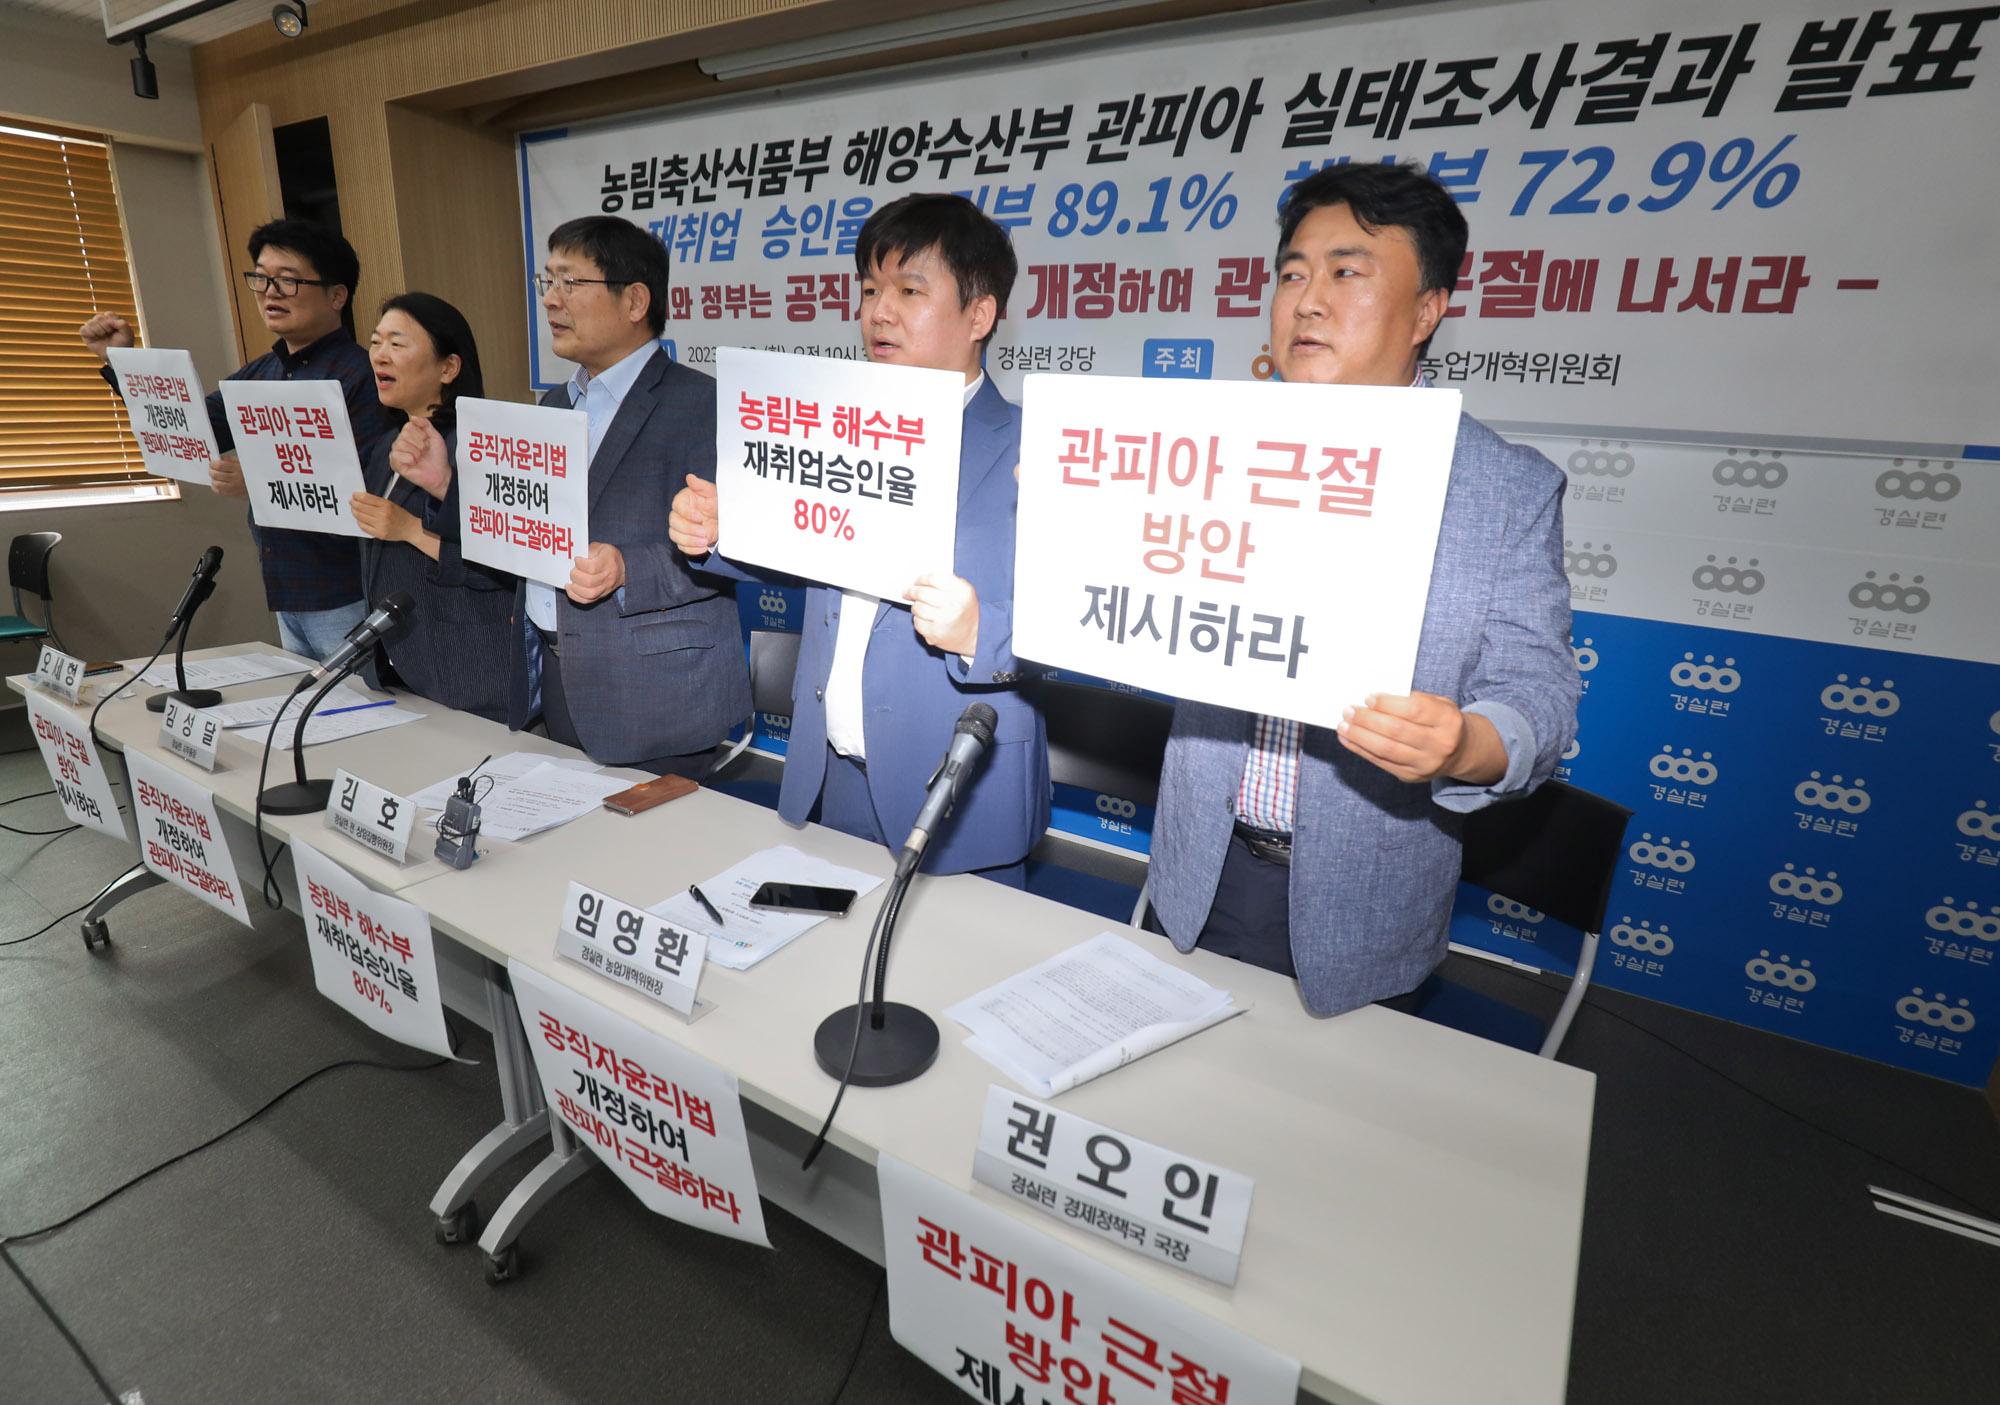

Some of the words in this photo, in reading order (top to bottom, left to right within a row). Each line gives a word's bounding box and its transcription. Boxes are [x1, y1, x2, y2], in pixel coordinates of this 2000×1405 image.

[600, 135, 833, 213] 농림축산식품부
[843, 103, 1074, 186] 해양수산부
[1086, 76, 1264, 165] 관피아
[1281, 23, 1762, 148] 실태조사결과
[1774, 5, 2000, 114] 발표
[1047, 171, 1238, 238] 89.1%
[1509, 134, 1801, 216] 72.9%
[701, 284, 772, 319] 정부는
[1027, 262, 1194, 320] 개정하여
[1617, 255, 1809, 314] 나서라
[998, 346, 1051, 371] 경실련
[1057, 346, 1096, 372] 강당
[1154, 347, 1202, 374] 주최
[124, 373, 191, 403] 공직자윤리법
[144, 404, 189, 432] 개정하여
[237, 406, 291, 438] 관피아
[295, 408, 334, 440] 근절
[737, 391, 821, 439] 농림부
[832, 405, 925, 456] 해수부
[276, 442, 313, 475] 방안
[469, 431, 567, 478] 공직자윤리법
[743, 440, 918, 506] 재취업승인율
[1058, 427, 1224, 501] 관피아
[1247, 440, 1382, 518] 근절
[267, 480, 339, 516] 제시하라
[485, 472, 549, 515] 개정하여
[1568, 484, 1625, 503] 경실련
[1712, 494, 1777, 516] 경실련
[469, 505, 511, 542] 관피아
[511, 514, 574, 560] 근절하라
[793, 500, 855, 541] 80%
[1874, 508, 1947, 530] 경실련
[1142, 512, 1256, 584] 방안
[1571, 585, 1608, 603] 실련
[1692, 599, 1754, 620] 경실련
[1080, 584, 1308, 679] 제시하라
[1848, 617, 1917, 641] 경실련
[1670, 694, 1731, 717] 경실련
[34, 713, 65, 752] 관피아
[65, 731, 91, 766] 근절
[1820, 717, 1887, 742] 경실련
[57, 752, 82, 786] 방안
[55, 779, 103, 824] 제시하라
[137, 778, 212, 842] 공직자윤리법
[1649, 784, 1707, 808] 경실련
[155, 817, 208, 866] 개정하여
[1098, 816, 1133, 835] 경실련
[1794, 811, 1858, 838] 경실련
[1955, 843, 2000, 866] 경실
[1629, 869, 1686, 895] 경실련
[306, 874, 353, 928] 농림부
[356, 908, 414, 965] 해수부
[1488, 919, 1537, 943] 경실련
[1768, 901, 1831, 928] 경실련
[315, 913, 419, 1002] 재취업승인율
[1610, 951, 1664, 977] 경실련
[1924, 936, 1994, 966] 경실련
[581, 945, 603, 968] 경실련
[605, 957, 664, 996] 농업개혁위원장
[352, 969, 393, 1014] 80%
[1744, 986, 1805, 1014] 경실련
[1894, 1026, 1962, 1055] 경실련
[538, 1010, 716, 1137] 공직자윤리법
[573, 1069, 690, 1162] 개정하여
[555, 1088, 623, 1161] 관피아
[624, 1137, 741, 1225] 근절하라
[1011, 1173, 1057, 1208] 경실련
[1064, 1195, 1146, 1246] 경제정책국
[1154, 1232, 1191, 1262] 국장
[916, 1215, 1080, 1343] 관피아
